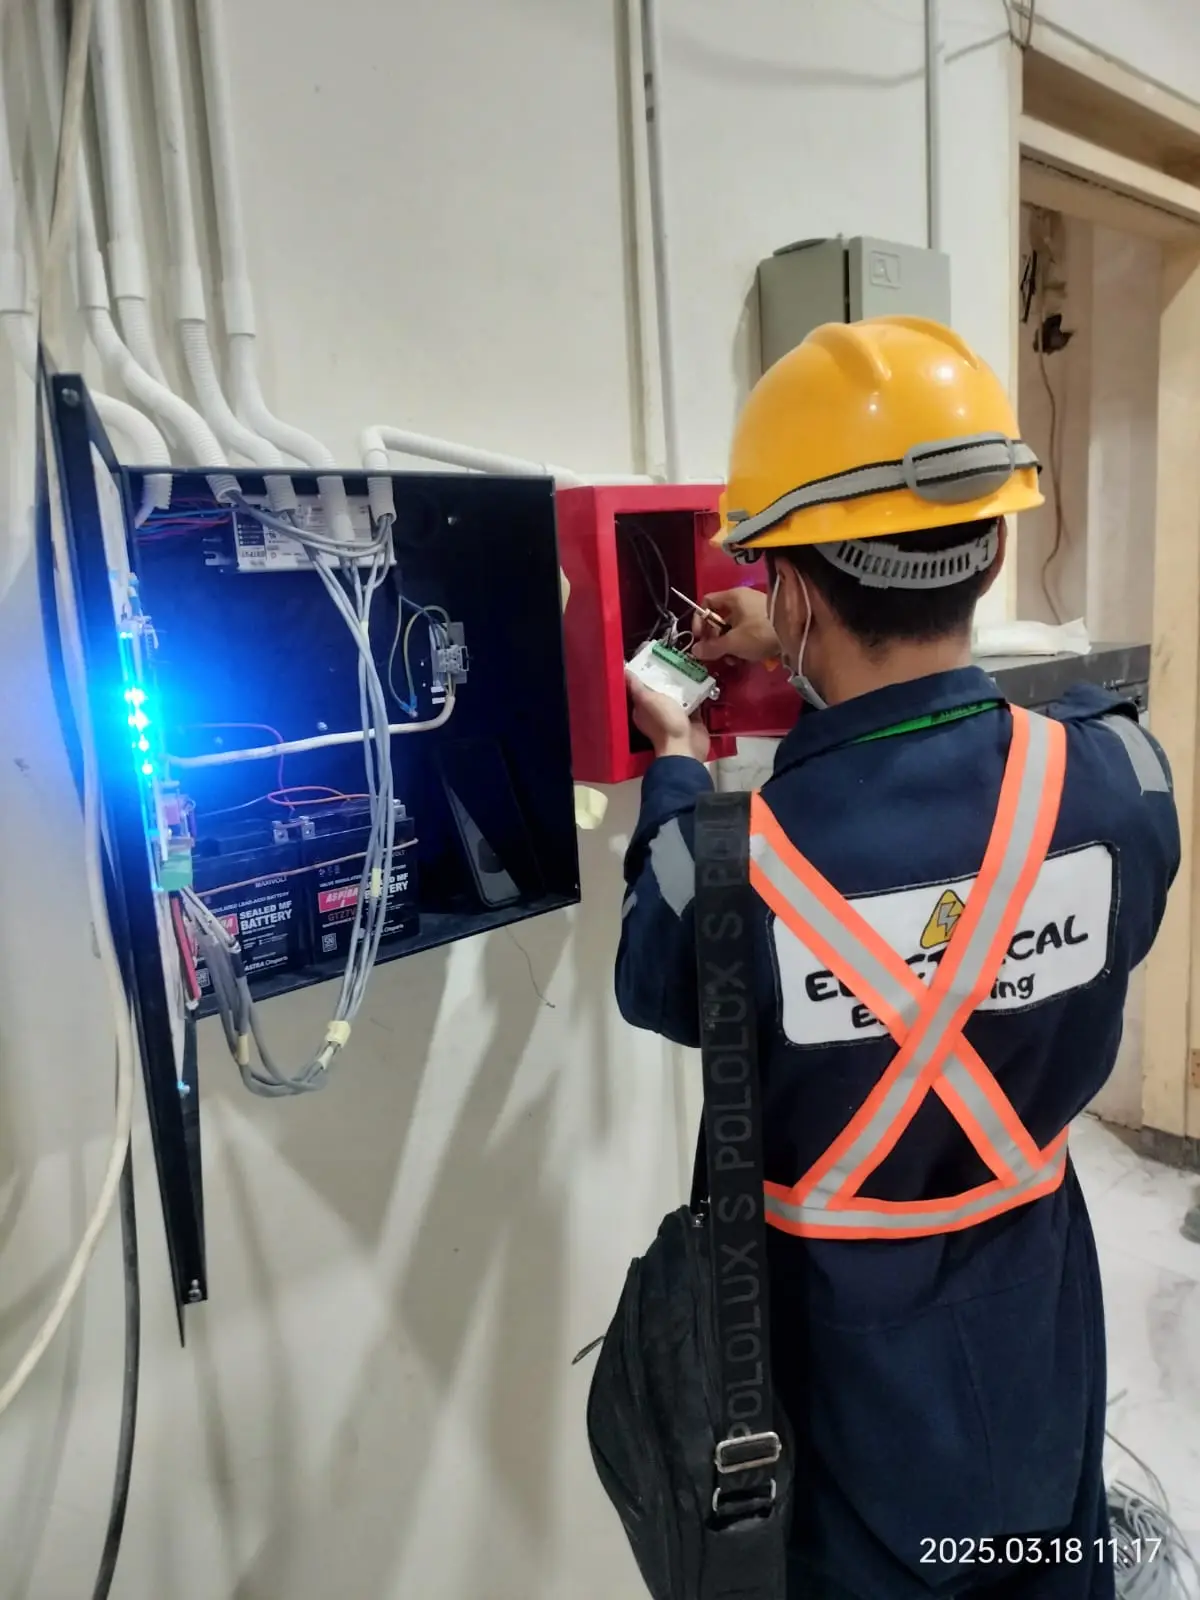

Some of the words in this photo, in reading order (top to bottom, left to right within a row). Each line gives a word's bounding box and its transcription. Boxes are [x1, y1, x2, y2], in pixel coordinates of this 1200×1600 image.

[396, 873, 409, 882] MF
[239, 904, 277, 920] SEALED
[278, 900, 293, 911] MF
[240, 909, 293, 931] BATTERY
[701, 909, 744, 942] S
[805, 915, 1089, 1001] ECCAL
[703, 961, 755, 1171] POLOLUX
[717, 1192, 757, 1224] S
[721, 1239, 763, 1440] POLOLUX
